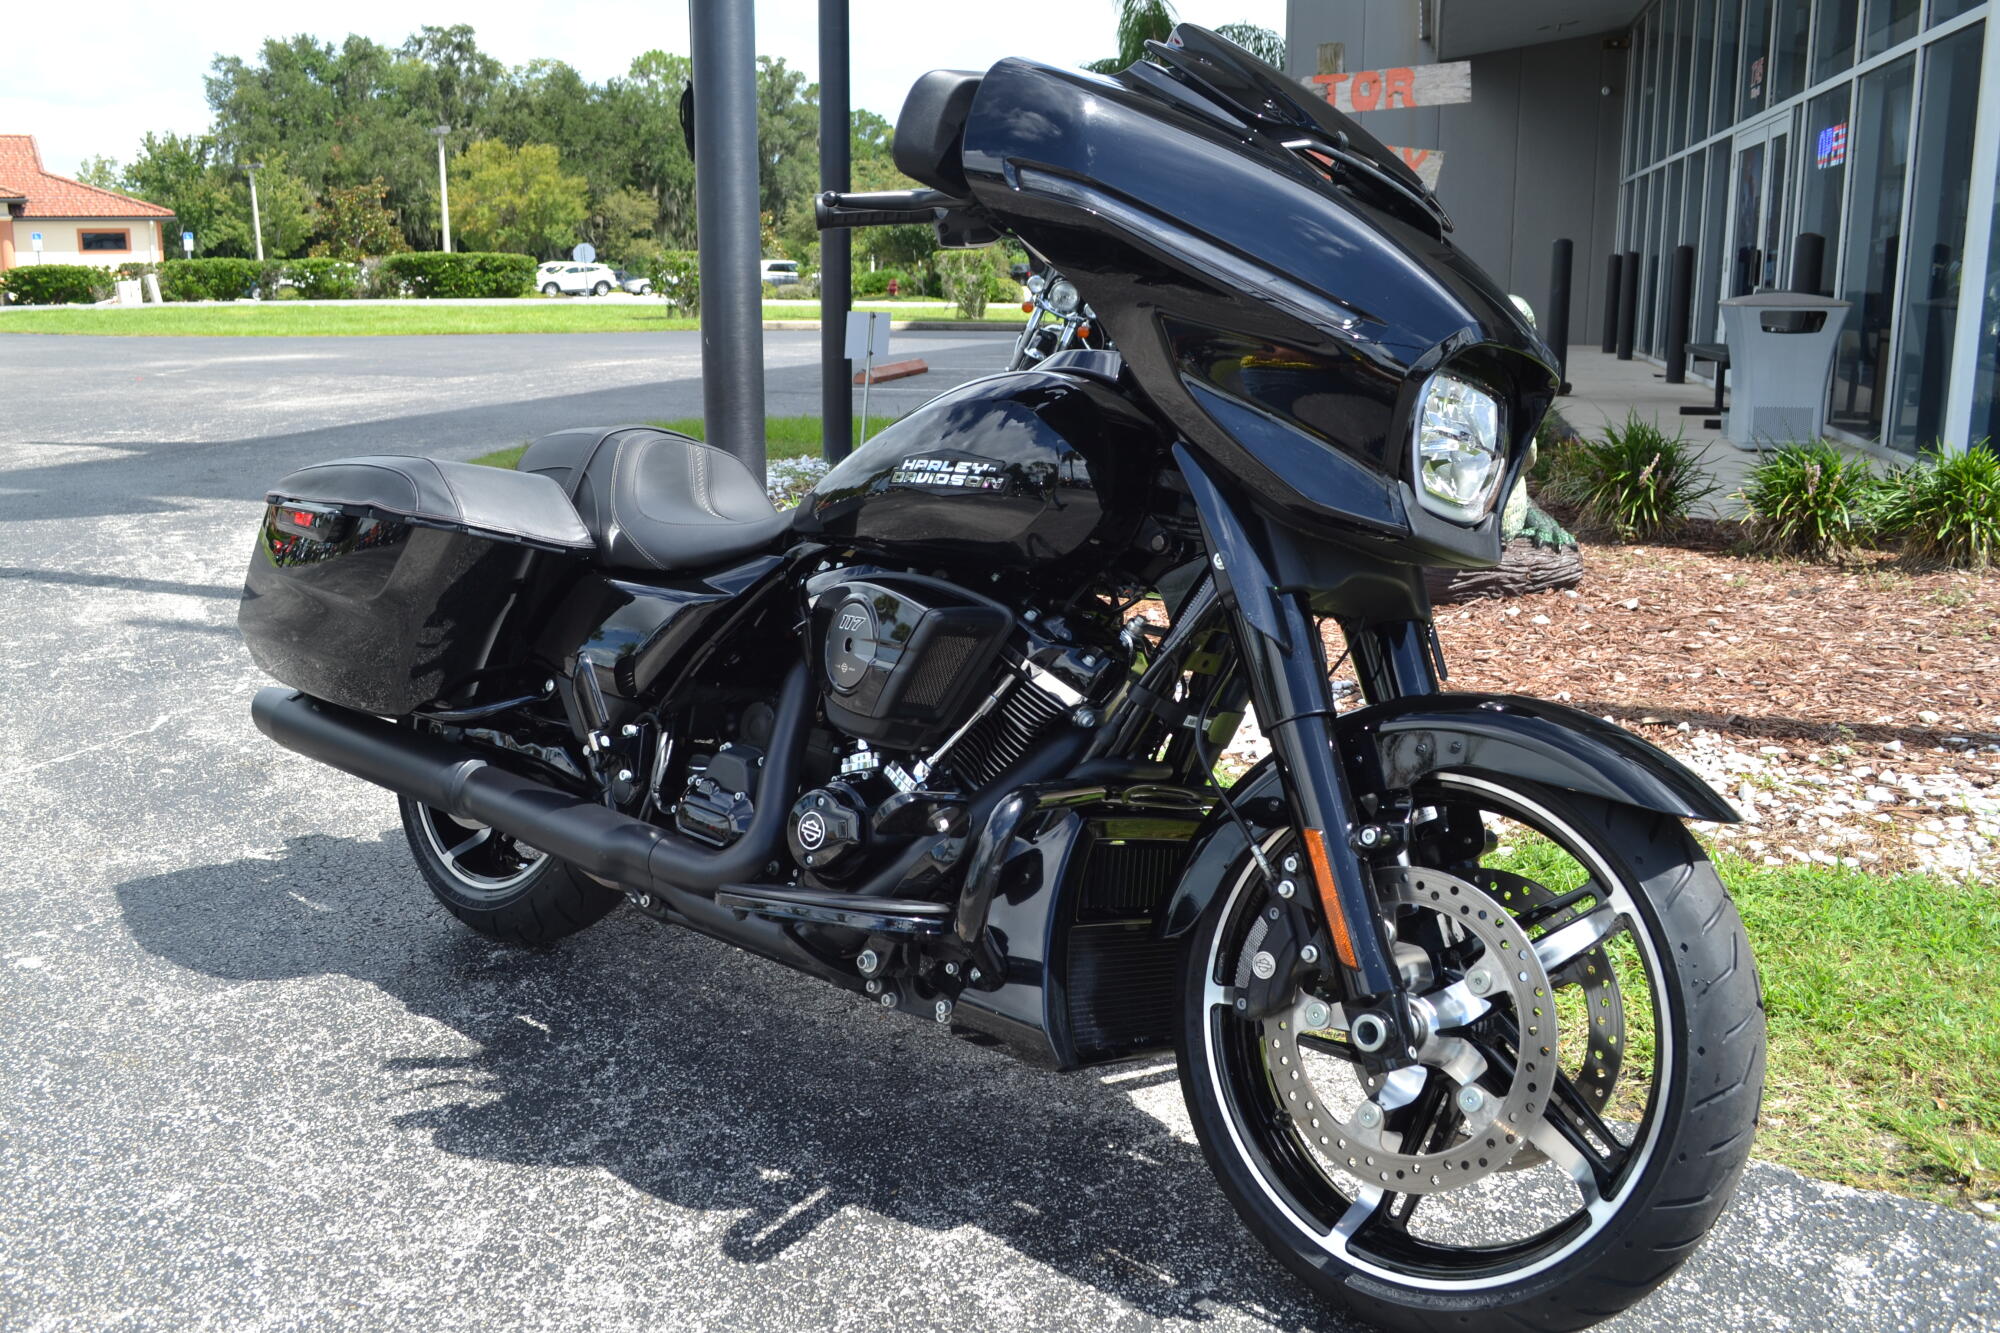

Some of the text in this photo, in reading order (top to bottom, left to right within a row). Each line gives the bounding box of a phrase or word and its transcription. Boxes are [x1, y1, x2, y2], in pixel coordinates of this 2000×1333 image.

[1312, 67, 1418, 112] TOR
[1817, 123, 1847, 170] OPEN
[902, 459, 996, 474] HARLEY-
[890, 471, 1004, 489] DAVIDSON
[839, 614, 866, 631] 117
